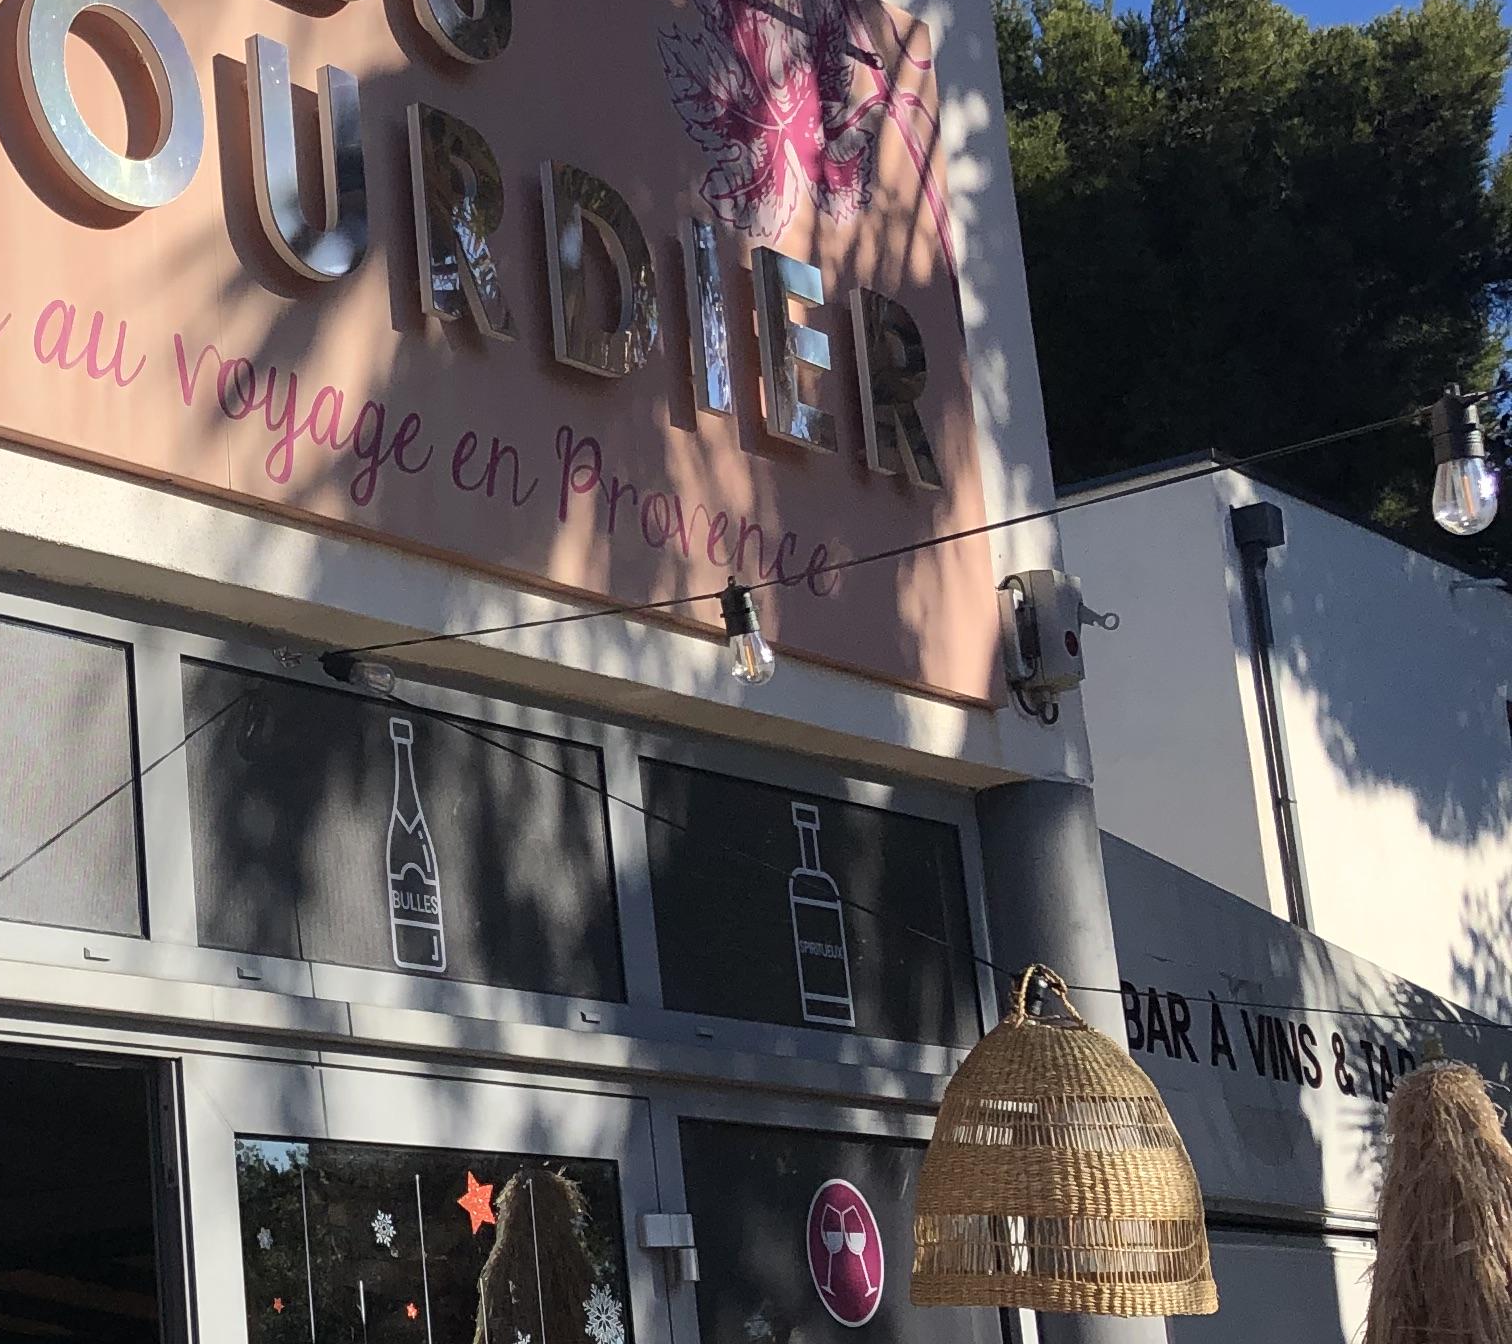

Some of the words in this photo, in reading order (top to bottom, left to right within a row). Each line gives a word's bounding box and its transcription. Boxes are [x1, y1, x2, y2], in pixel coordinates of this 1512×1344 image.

[33, 298, 147, 387] au
[173, 332, 434, 507] voyage
[452, 429, 540, 507] en
[556, 424, 844, 598] Provence
[391, 889, 439, 915] BULLES
[1120, 980, 1200, 1064] BAR
[1208, 989, 1238, 1072] À
[1240, 1008, 1324, 1090] VINS
[1331, 1032, 1358, 1098] &
